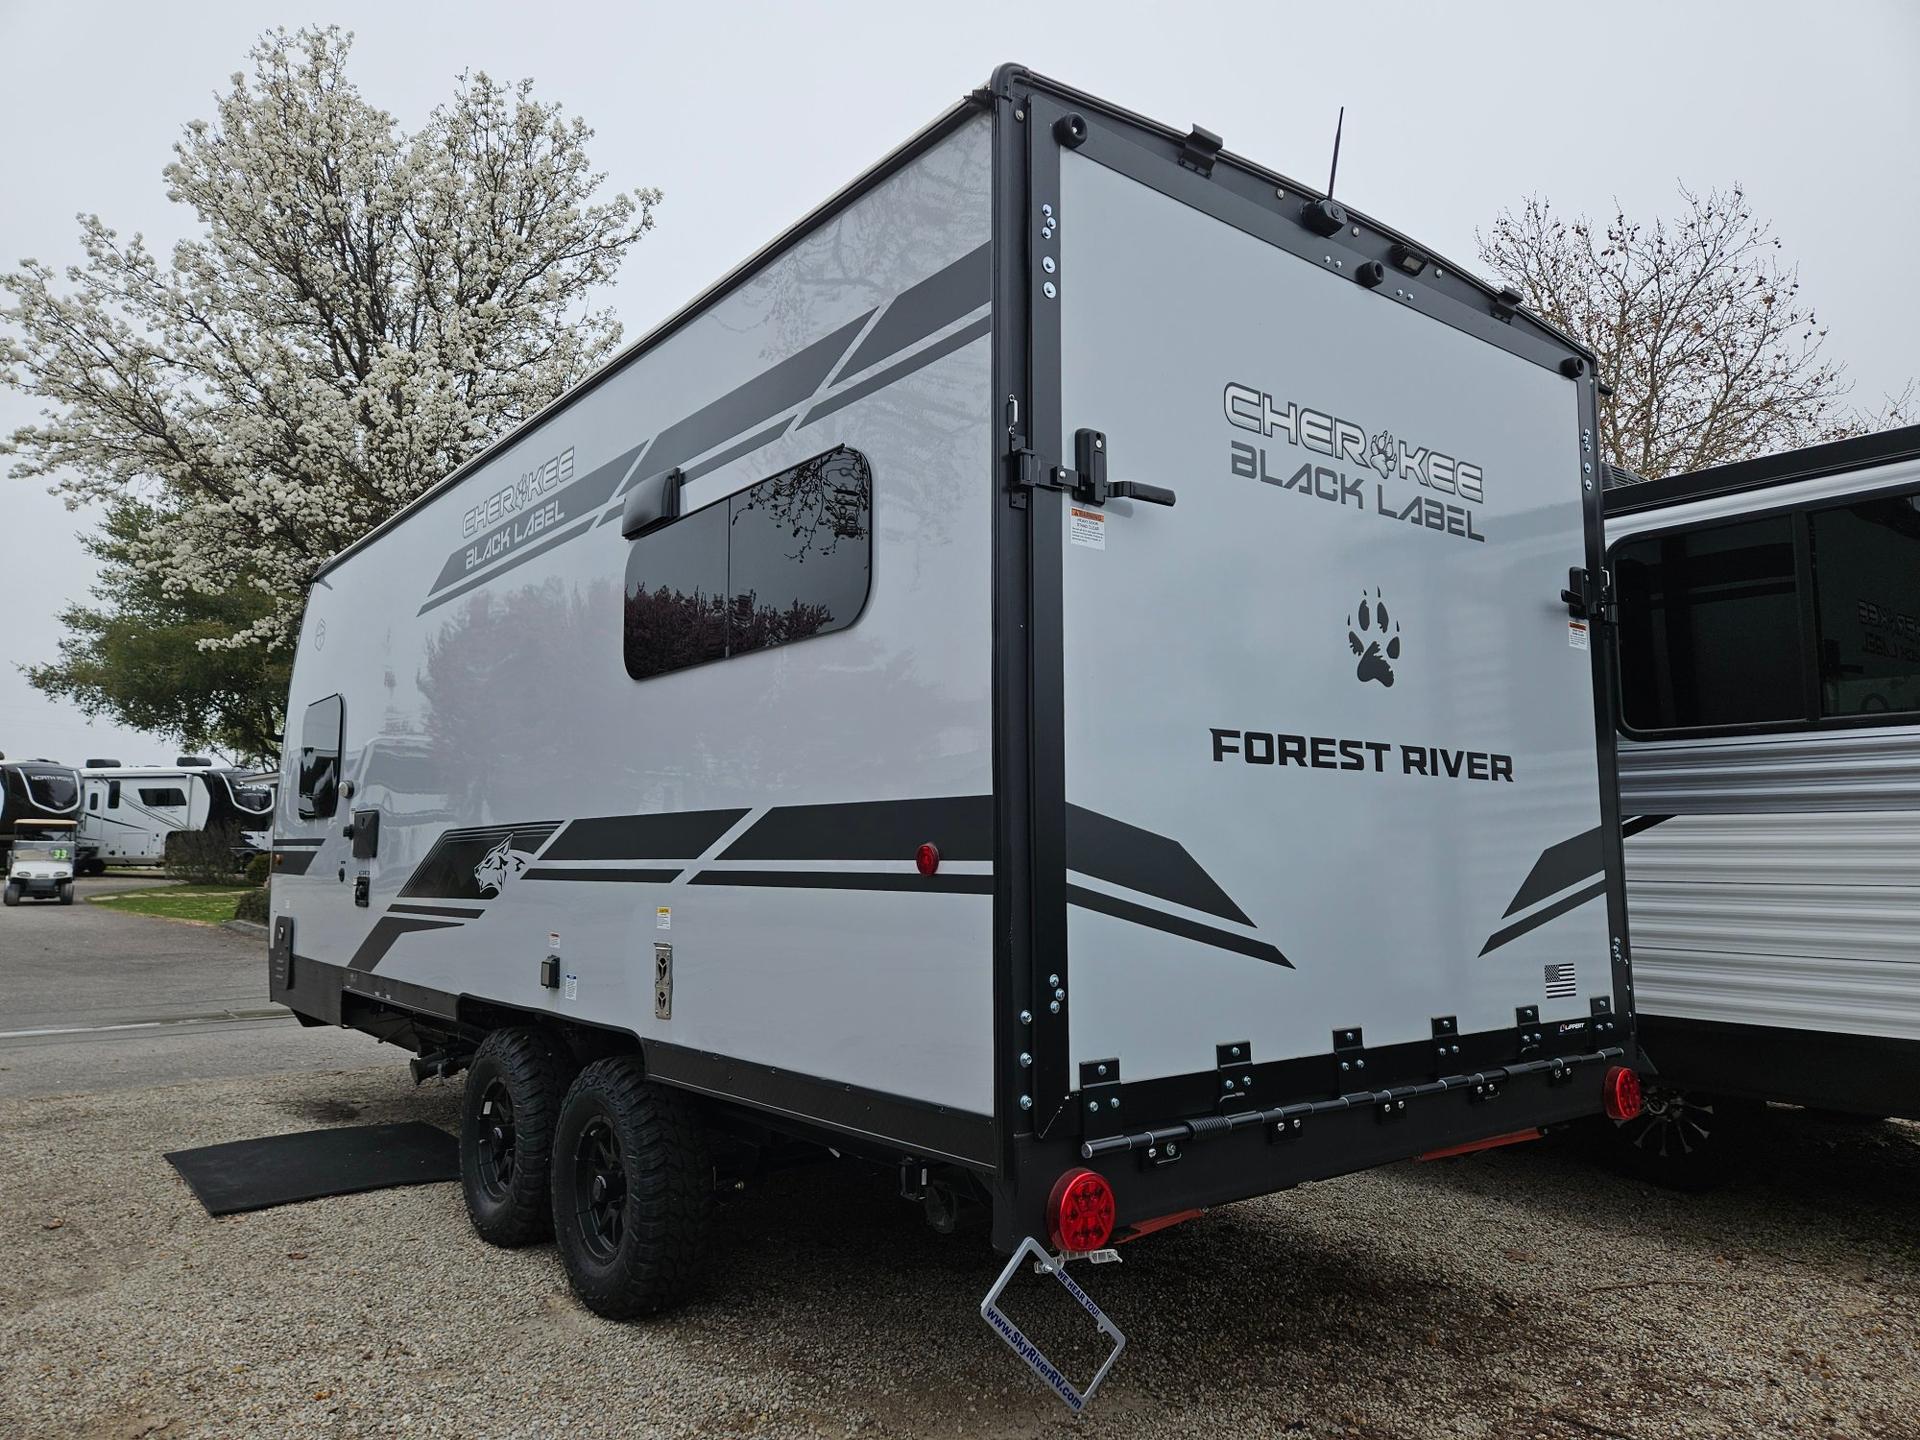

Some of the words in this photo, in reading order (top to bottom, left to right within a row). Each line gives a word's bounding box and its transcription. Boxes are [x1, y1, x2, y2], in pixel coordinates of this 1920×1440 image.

[1230, 439, 1364, 510] BLACK
[1377, 483, 1485, 543] LABEL
[465, 527, 511, 570] BLACK
[514, 500, 565, 544] LABEL
[1208, 727, 1391, 773] FOREST
[1399, 744, 1514, 783] RIVER
[1057, 1269, 1068, 1283] WE
[1067, 1280, 1086, 1304] HEAR
[1084, 1299, 1101, 1317] YOU!
[986, 1307, 1082, 1410] www.SkyRiverRV.com
